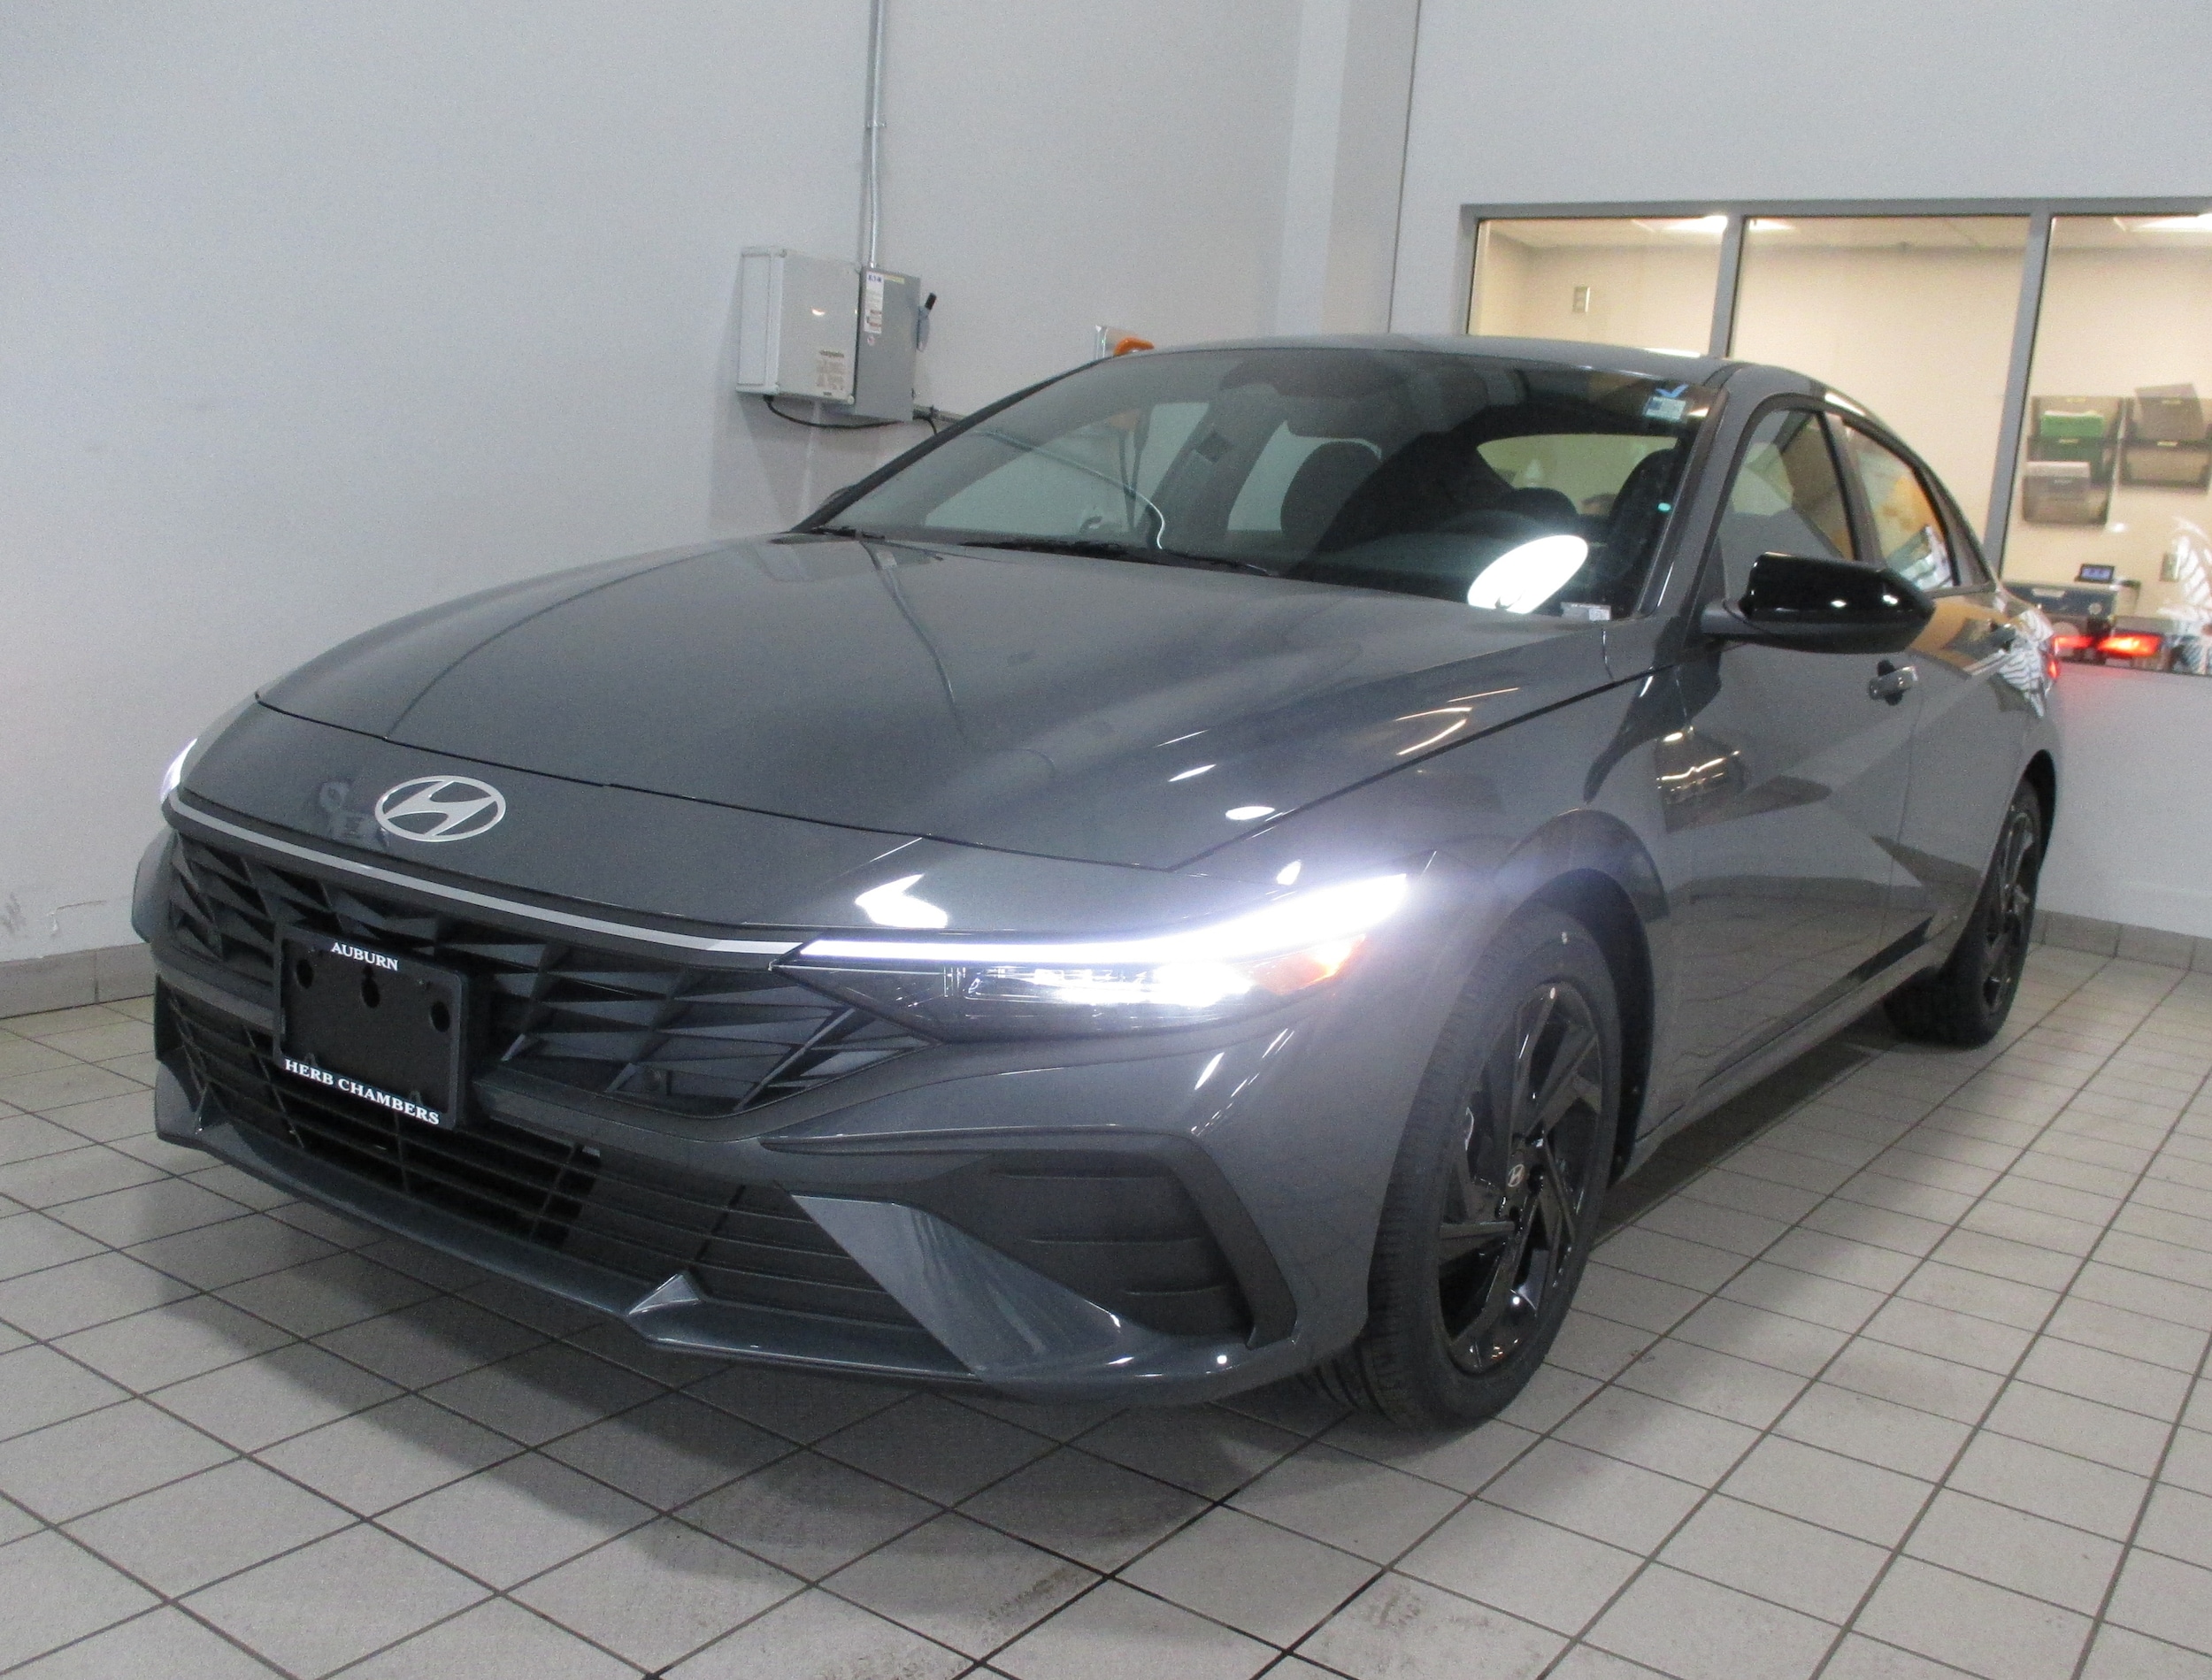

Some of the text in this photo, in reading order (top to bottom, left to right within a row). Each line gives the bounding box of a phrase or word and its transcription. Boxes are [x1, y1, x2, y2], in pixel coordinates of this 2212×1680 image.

[330, 941, 398, 971] AUBURN
[285, 1058, 440, 1125] HERB CHAMBERS
